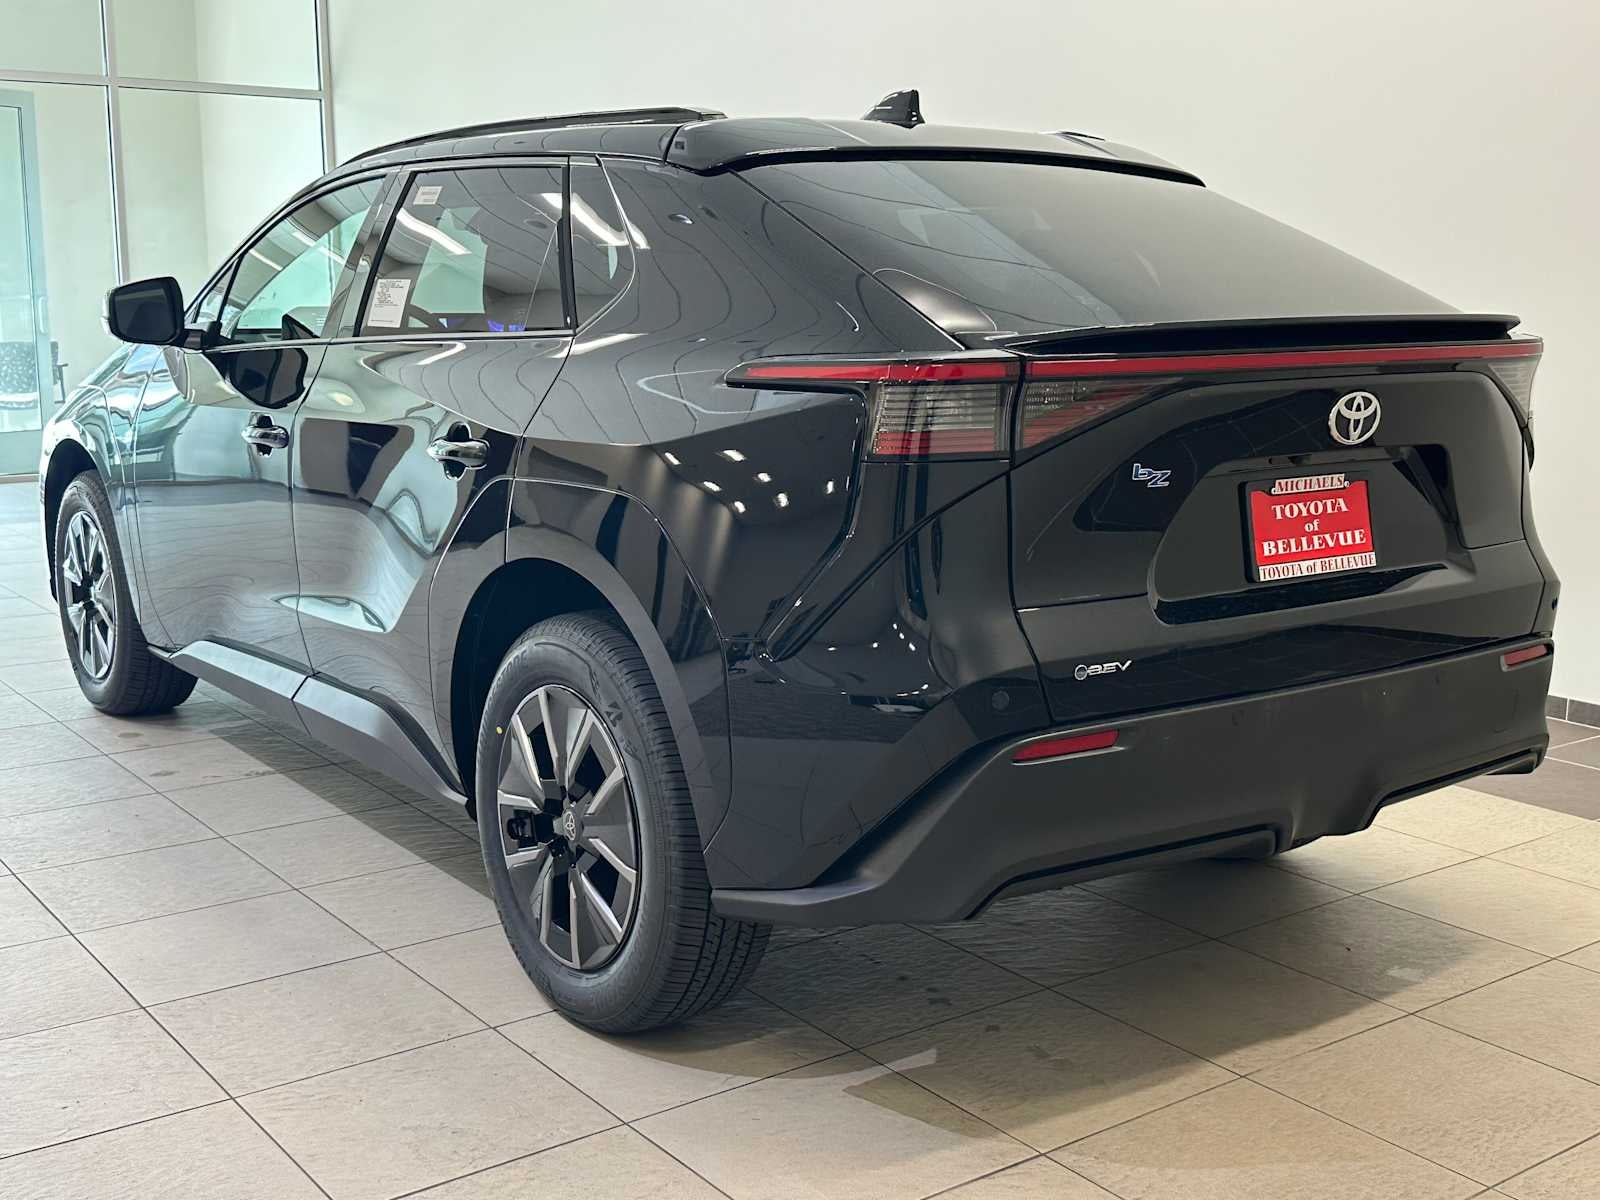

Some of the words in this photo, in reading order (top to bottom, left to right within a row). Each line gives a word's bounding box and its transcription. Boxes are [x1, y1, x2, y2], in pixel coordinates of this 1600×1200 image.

[1276, 475, 1344, 493] MICHAELS
[1271, 497, 1349, 520] TOYOTA
[1304, 519, 1320, 533] of
[1261, 529, 1367, 557] BELLEVUE
[1260, 563, 1304, 580] TOYOTA
[1306, 561, 1319, 574] of
[1320, 554, 1376, 572] BELLEVUE
